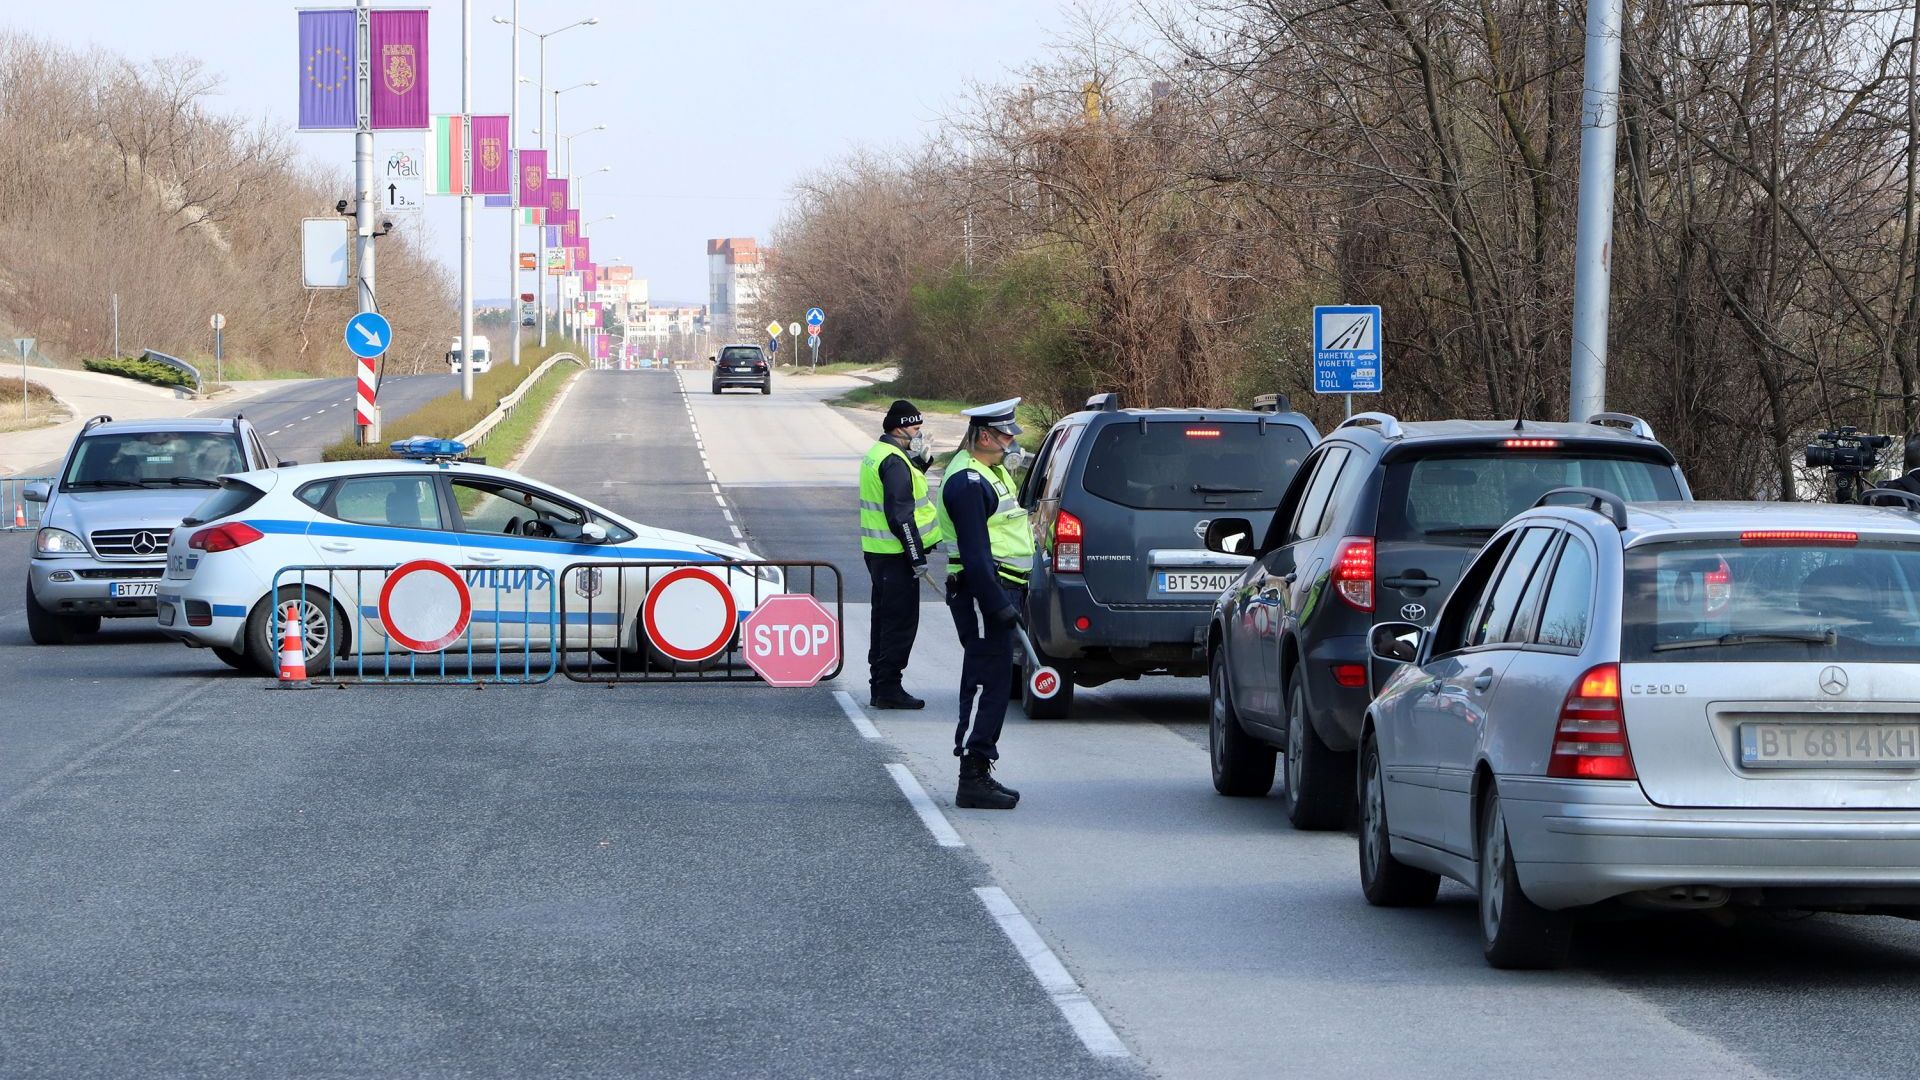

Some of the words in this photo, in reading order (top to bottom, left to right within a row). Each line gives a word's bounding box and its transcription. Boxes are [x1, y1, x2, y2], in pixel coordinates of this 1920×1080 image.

[387, 160, 419, 176] Mall
[399, 195, 405, 206] 3
[1320, 370, 1337, 379] ТОЛ
[1320, 380, 1341, 388] TOLL
[1168, 575, 1188, 590] BT
[1190, 575, 1227, 590] 5940
[118, 585, 134, 596] BT
[754, 624, 829, 656] STOP
[1646, 684, 1688, 695] 200
[1761, 728, 1797, 757] BT
[1804, 728, 1873, 758] 6814
[1877, 729, 1915, 757] KH
